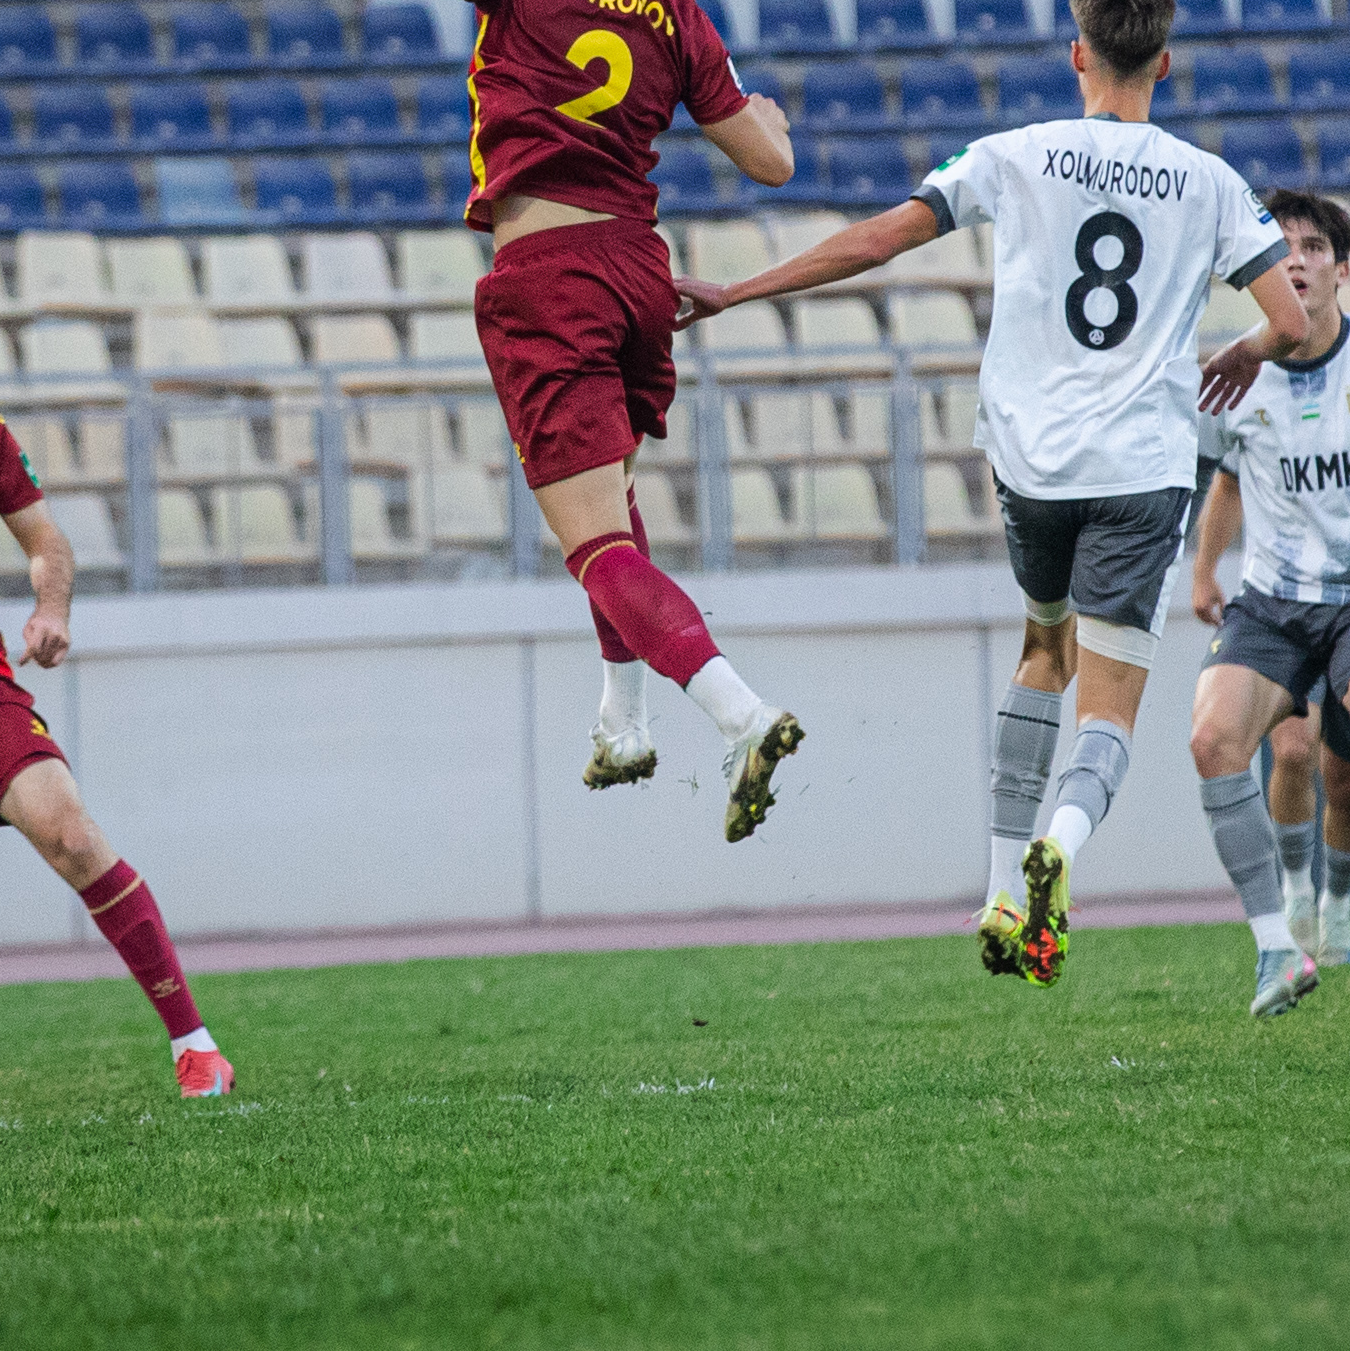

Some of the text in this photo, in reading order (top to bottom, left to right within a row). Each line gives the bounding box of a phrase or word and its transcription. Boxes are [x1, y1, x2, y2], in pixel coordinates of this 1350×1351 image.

[556, 29, 634, 129] 2
[1042, 149, 1188, 201] XOLMURODOV
[1065, 211, 1144, 351] 8
